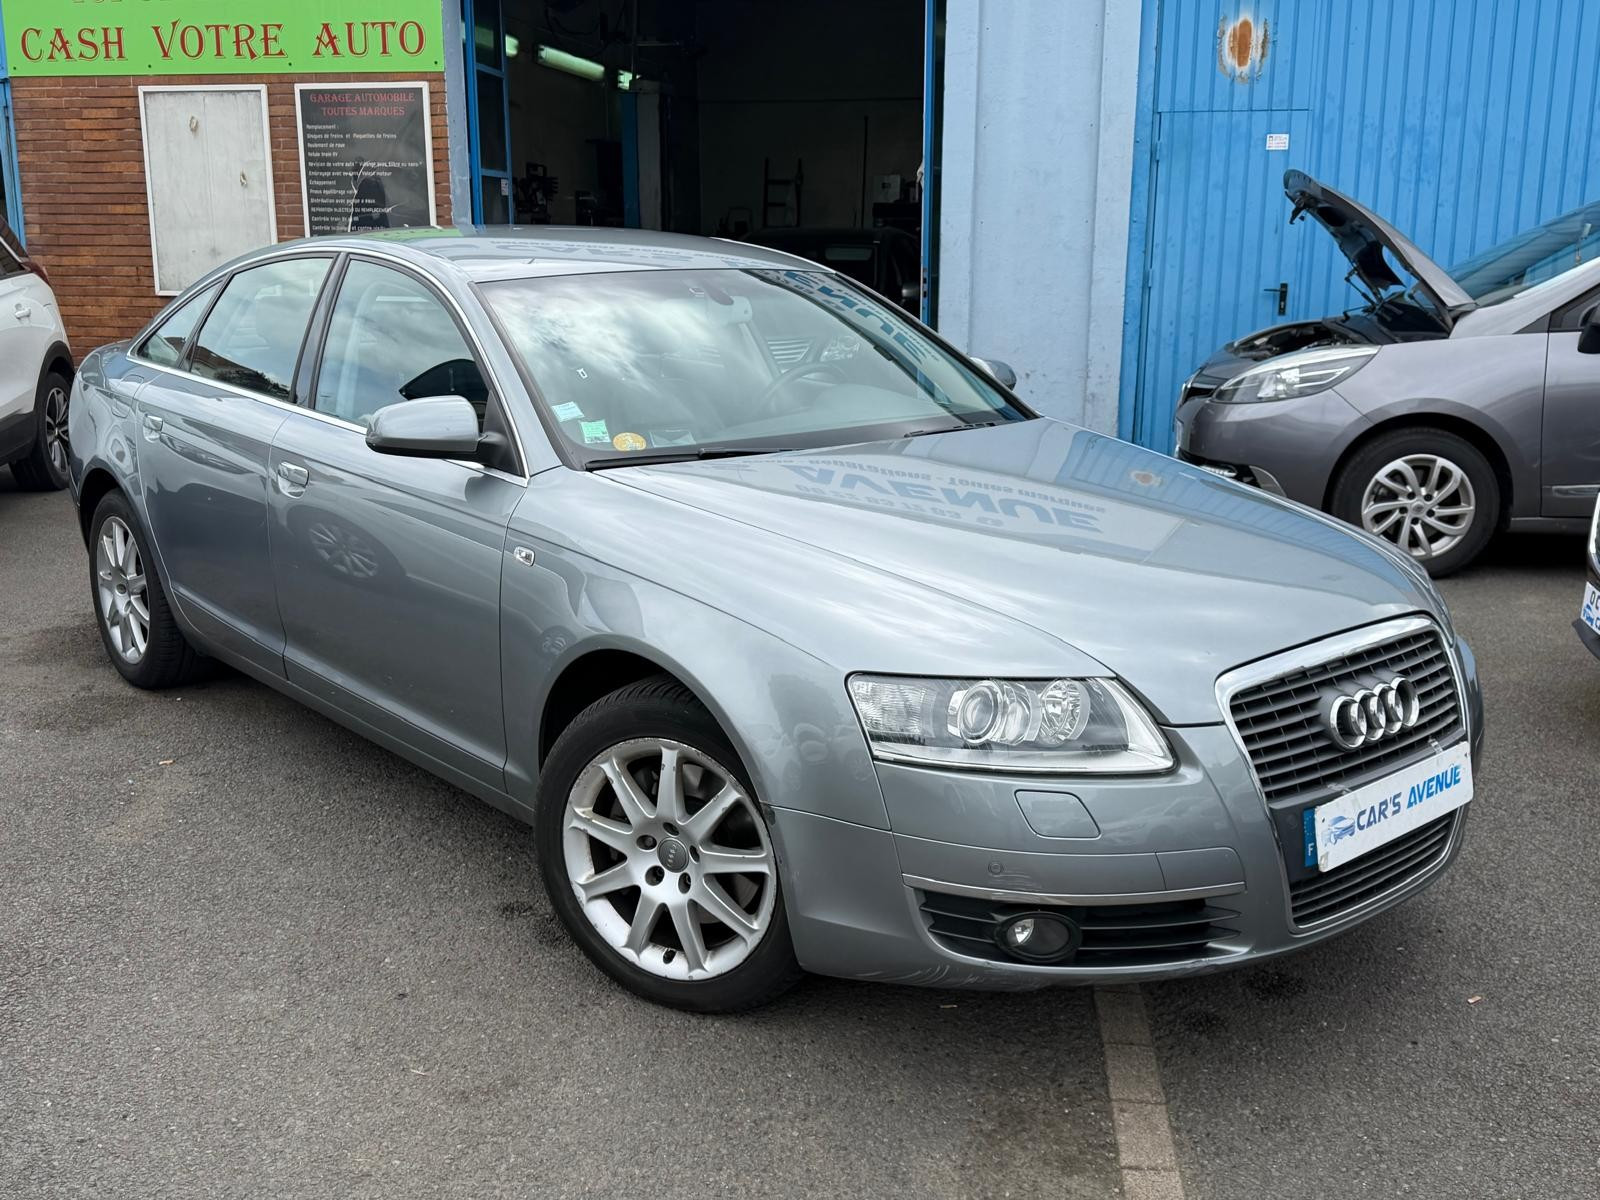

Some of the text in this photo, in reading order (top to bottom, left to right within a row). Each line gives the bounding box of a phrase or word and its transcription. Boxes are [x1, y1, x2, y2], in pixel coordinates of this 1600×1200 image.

[21, 18, 426, 62] CASH VOTRE AUTO
[310, 91, 415, 104] GARAGE AUTOMOBILE
[322, 106, 405, 116] TOUTES MARQUES
[1356, 763, 1462, 831] CAR'S AVENUE
[1307, 843, 1315, 857] F
